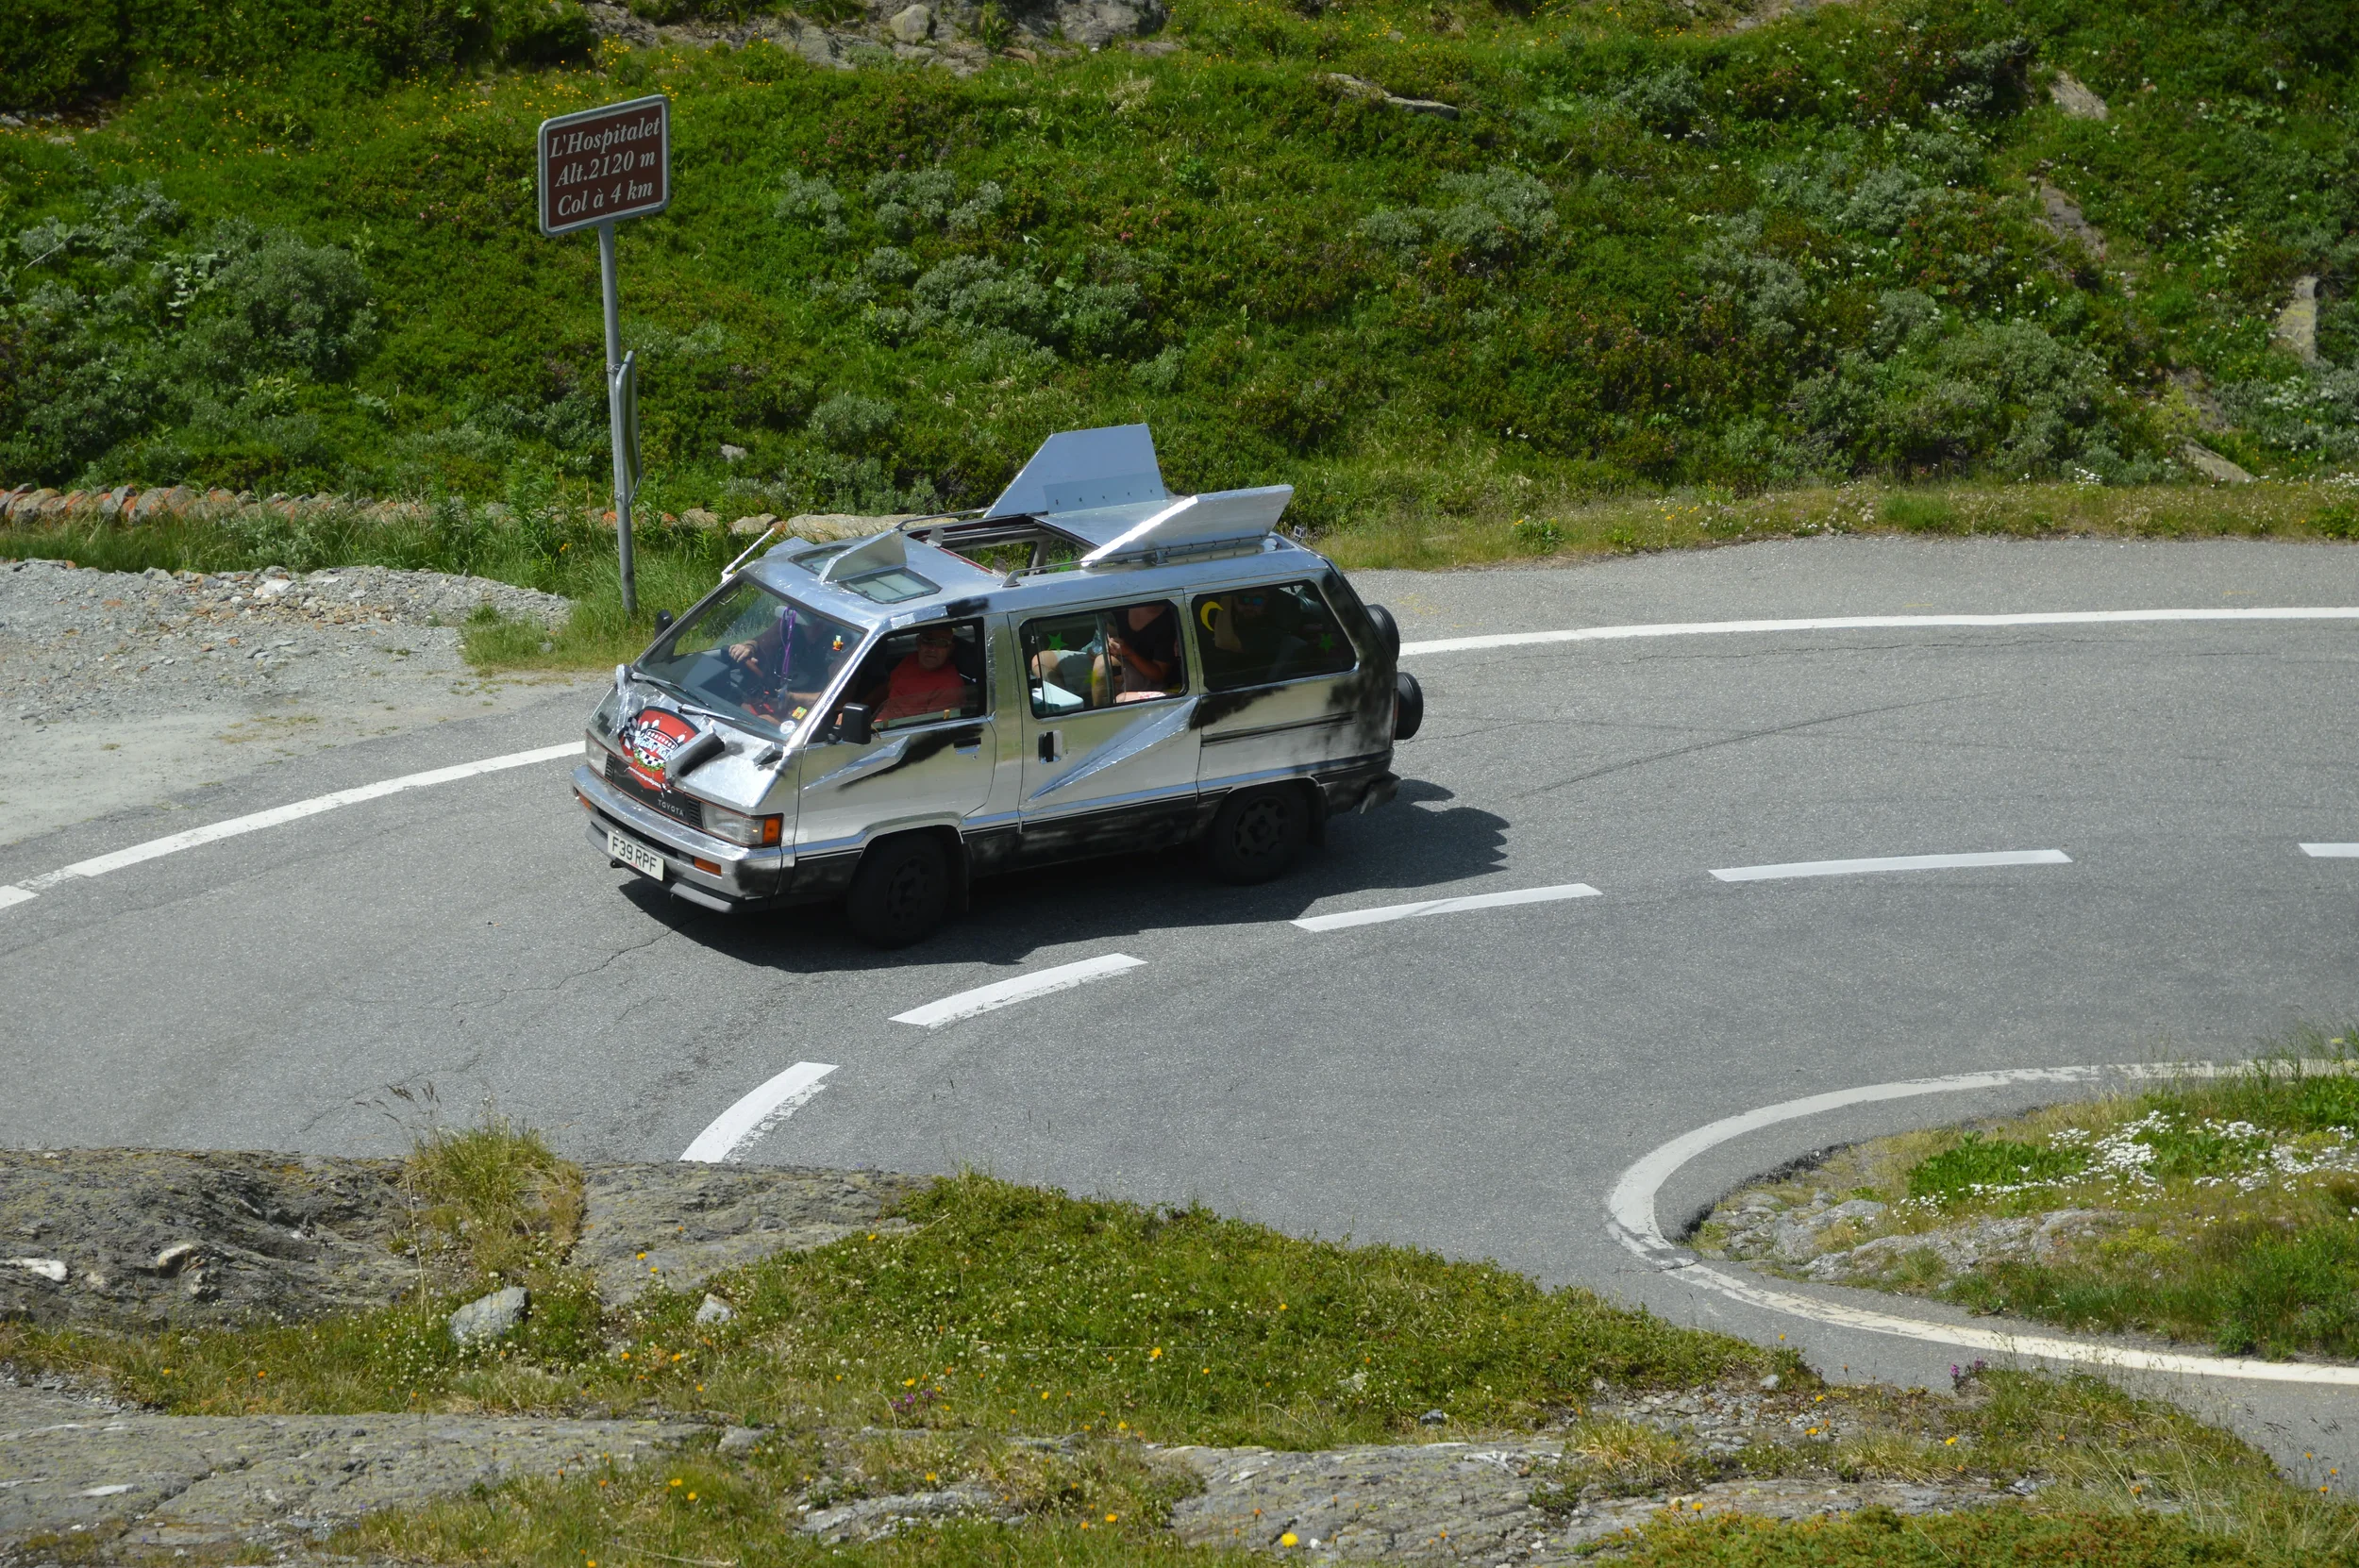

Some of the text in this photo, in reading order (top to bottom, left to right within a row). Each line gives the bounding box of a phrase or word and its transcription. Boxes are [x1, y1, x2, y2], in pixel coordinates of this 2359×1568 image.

[549, 117, 661, 158] L'Hospitalet
[555, 150, 656, 187] Alt.2120 m
[558, 179, 653, 216] Col à 4 km
[658, 799, 684, 817] TOYOTA
[612, 836, 657, 872] F39 RPF
